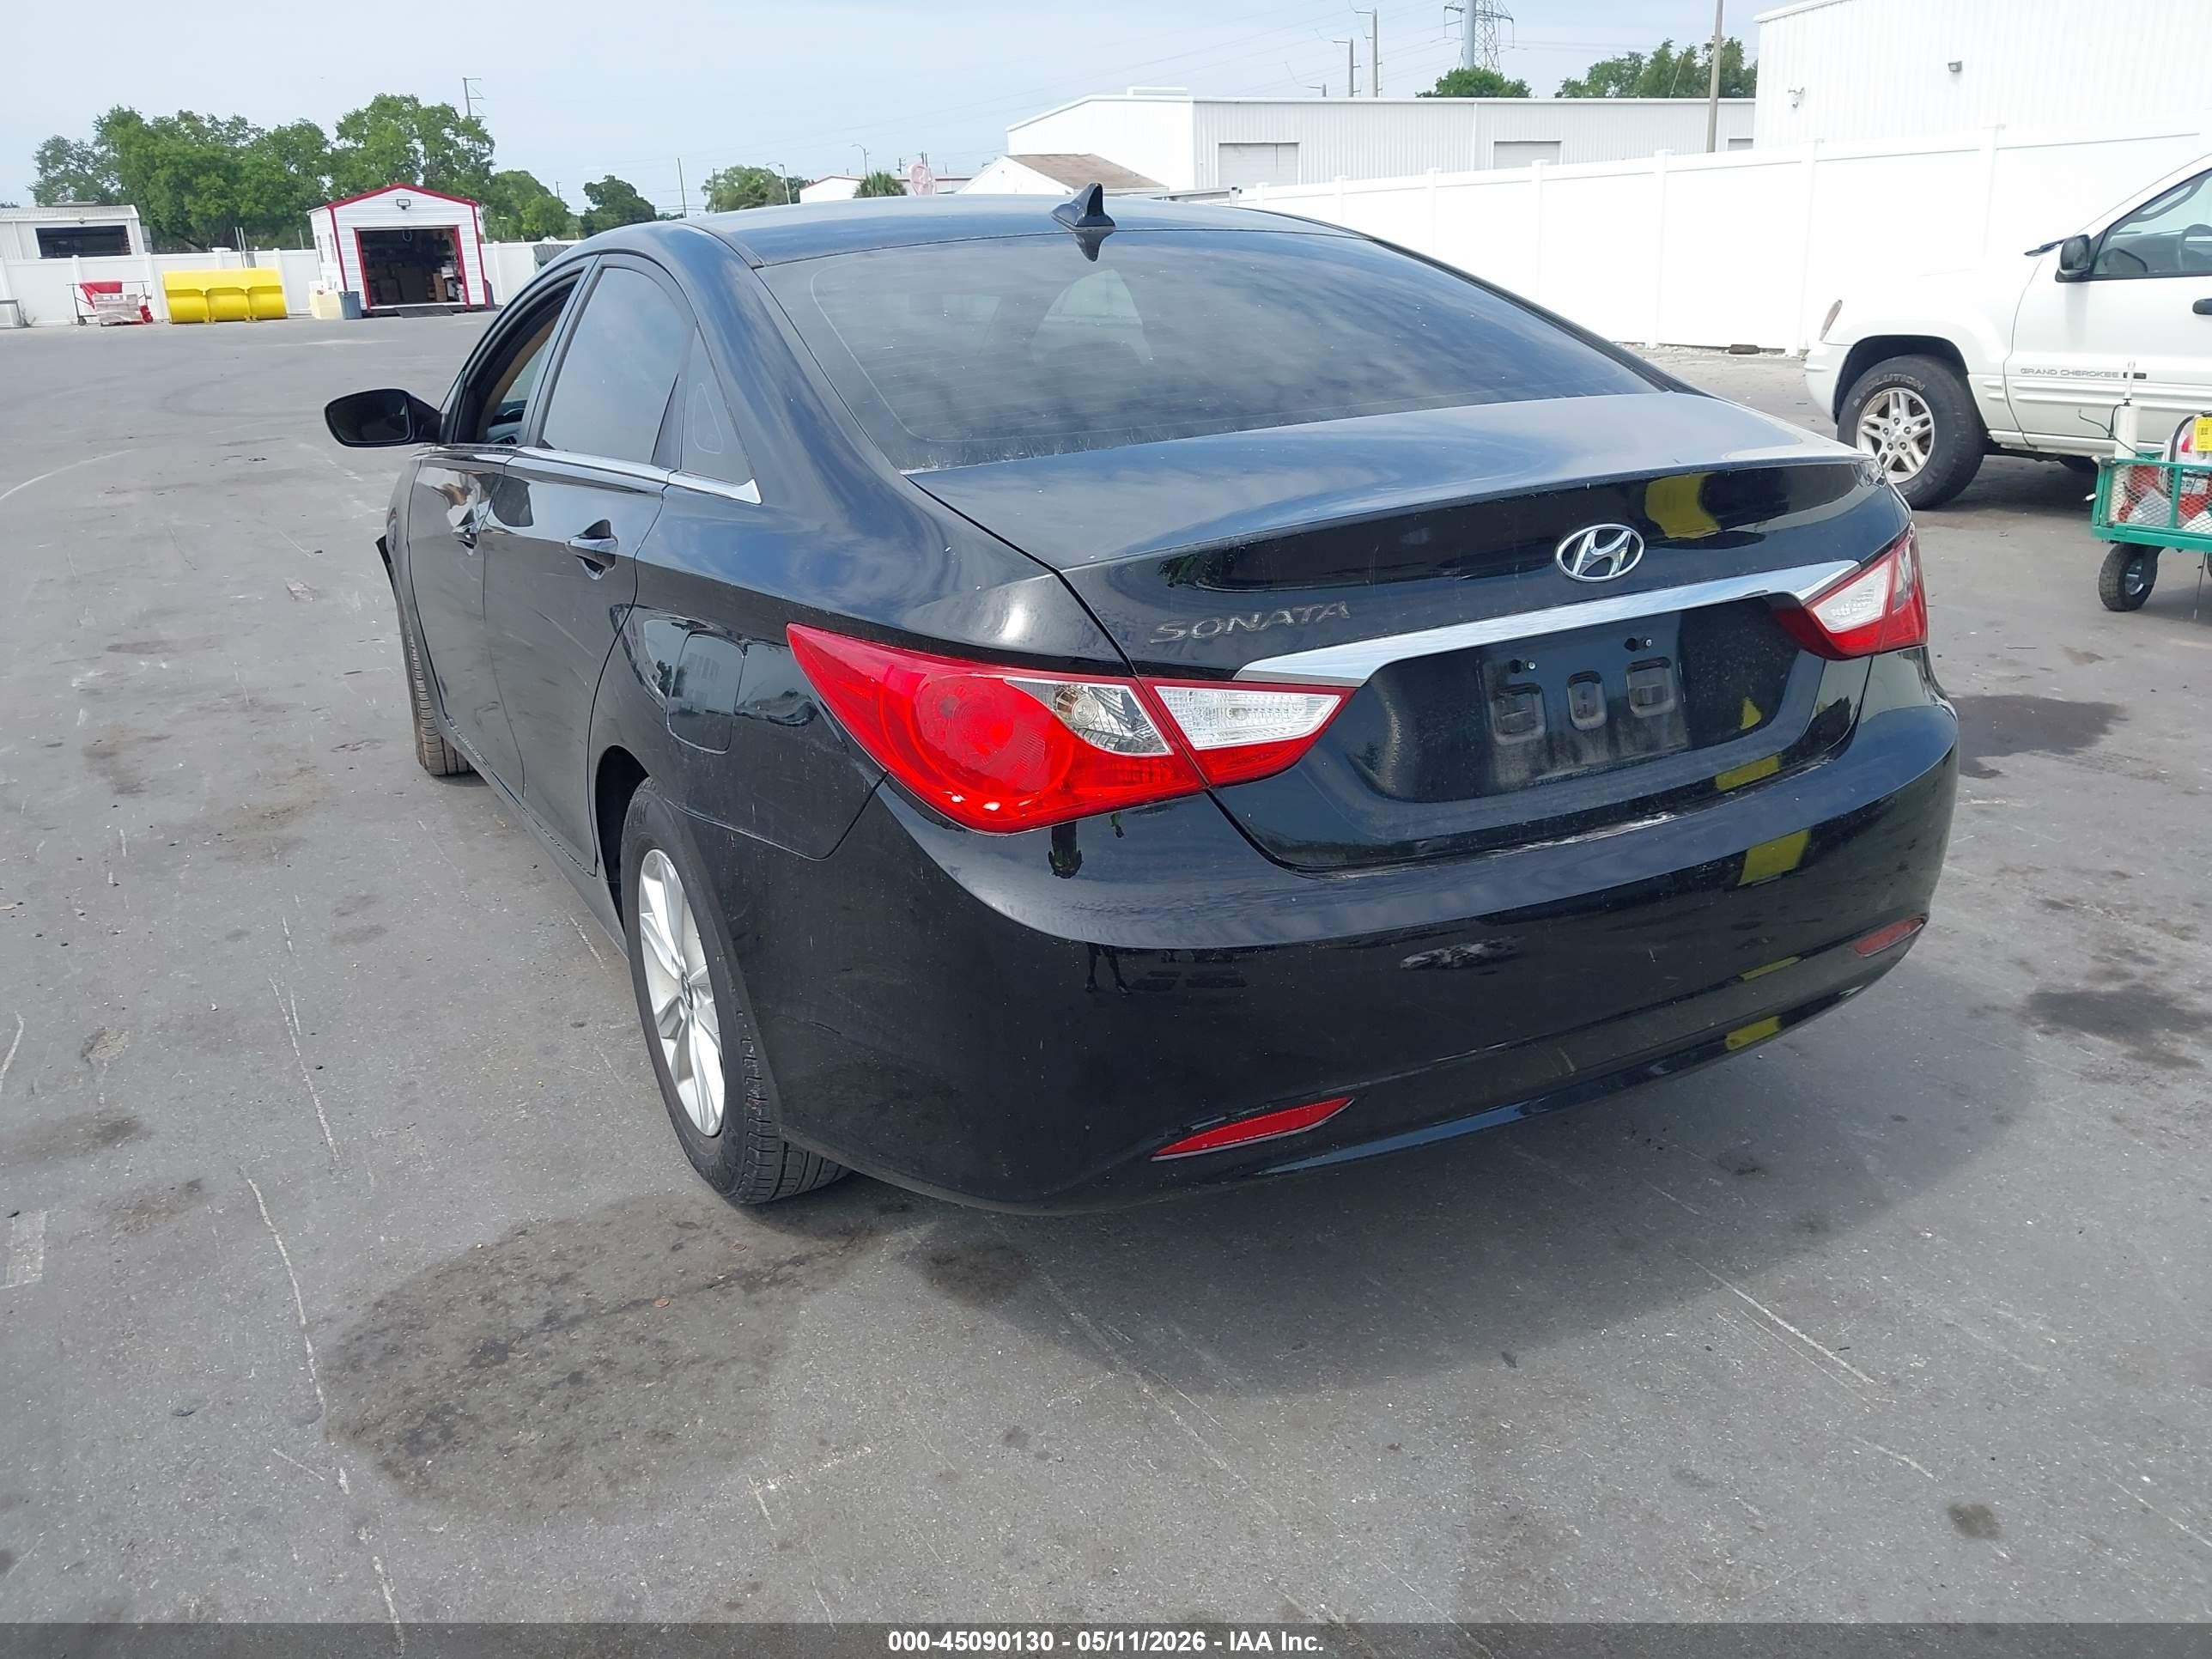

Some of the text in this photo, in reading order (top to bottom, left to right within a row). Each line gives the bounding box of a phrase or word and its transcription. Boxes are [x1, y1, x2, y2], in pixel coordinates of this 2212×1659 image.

[2020, 368, 2120, 379] GRAND CHEROKEE
[1149, 599, 1352, 644] SONATA
